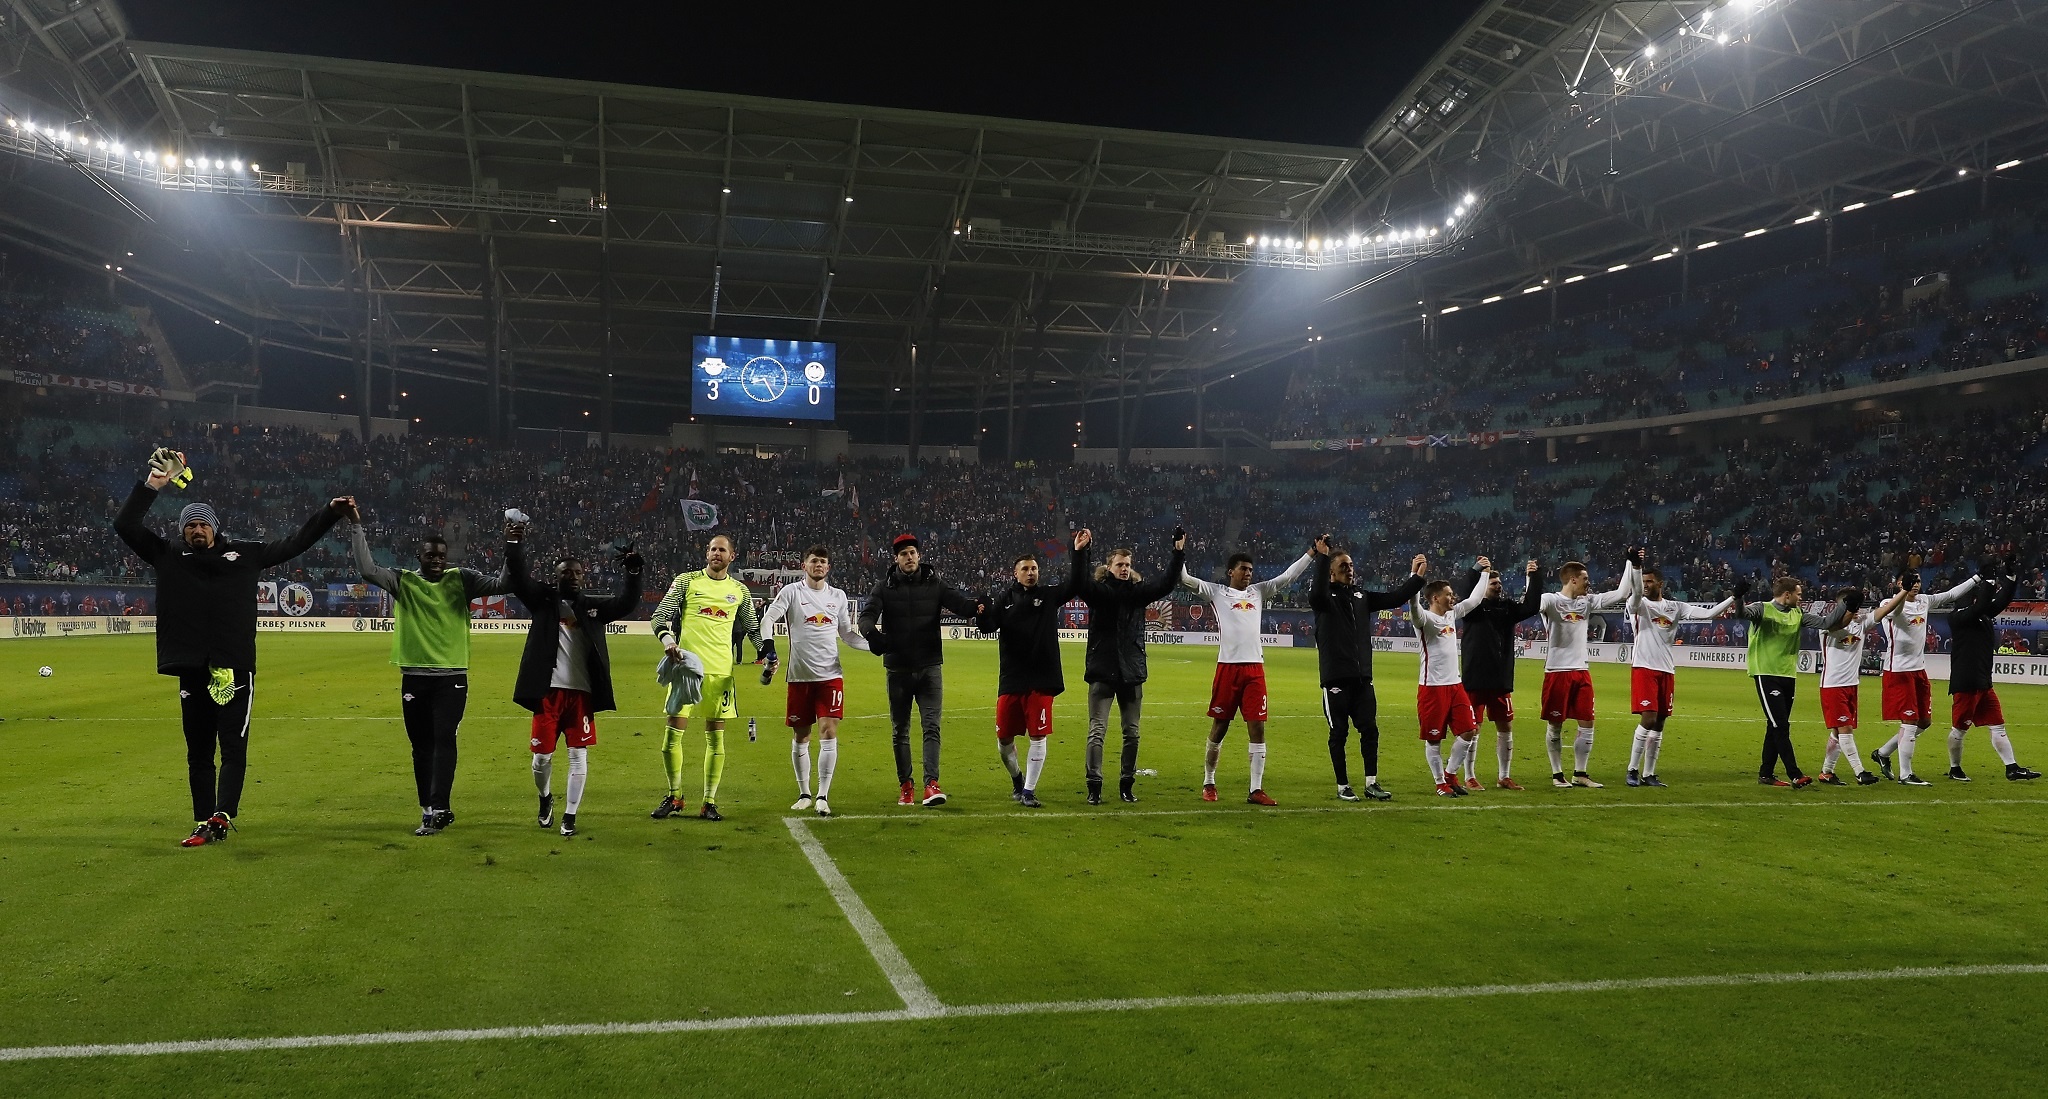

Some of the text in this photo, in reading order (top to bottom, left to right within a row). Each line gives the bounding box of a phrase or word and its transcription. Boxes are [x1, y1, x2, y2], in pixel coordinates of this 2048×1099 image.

[48, 373, 160, 397] LIPSIA
[707, 380, 719, 400] 3
[808, 384, 820, 405] 0
[2005, 604, 2035, 614] Family
[288, 620, 327, 628] PILSNER
[2000, 617, 2032, 627] Friends
[1689, 651, 1735, 663] FEINHERBES
[831, 690, 842, 706] 19
[1261, 694, 1267, 711] 3
[583, 715, 590, 734] 8
[1040, 708, 1046, 725] 4
